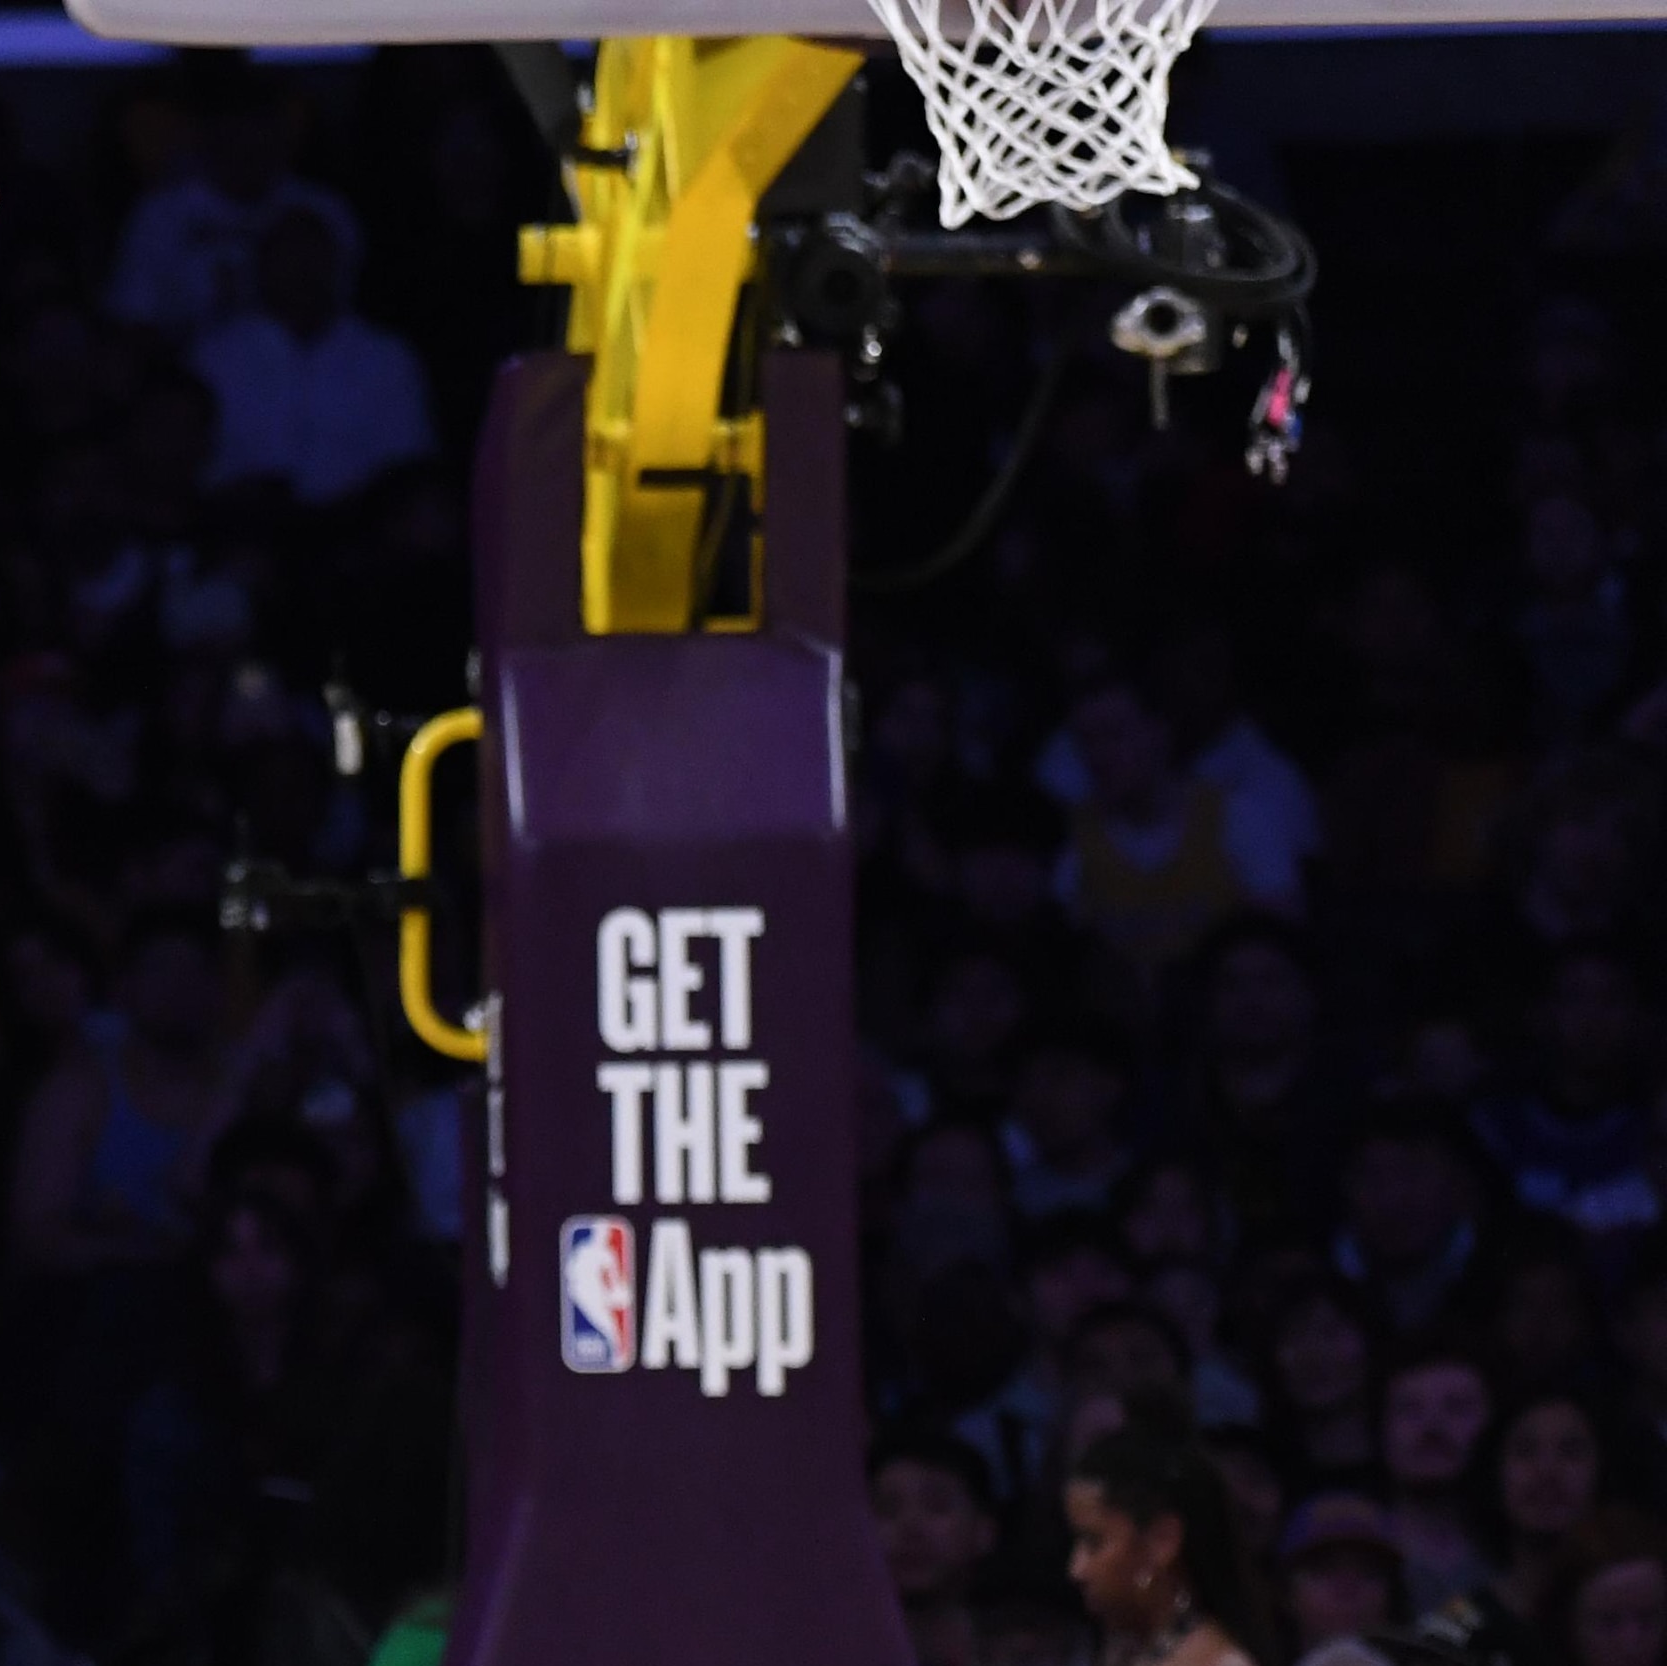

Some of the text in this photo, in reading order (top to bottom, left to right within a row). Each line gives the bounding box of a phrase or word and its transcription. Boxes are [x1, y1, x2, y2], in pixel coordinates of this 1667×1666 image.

[597, 907, 765, 1051] GET
[596, 1061, 771, 1205] THE
[641, 1218, 814, 1397] App
